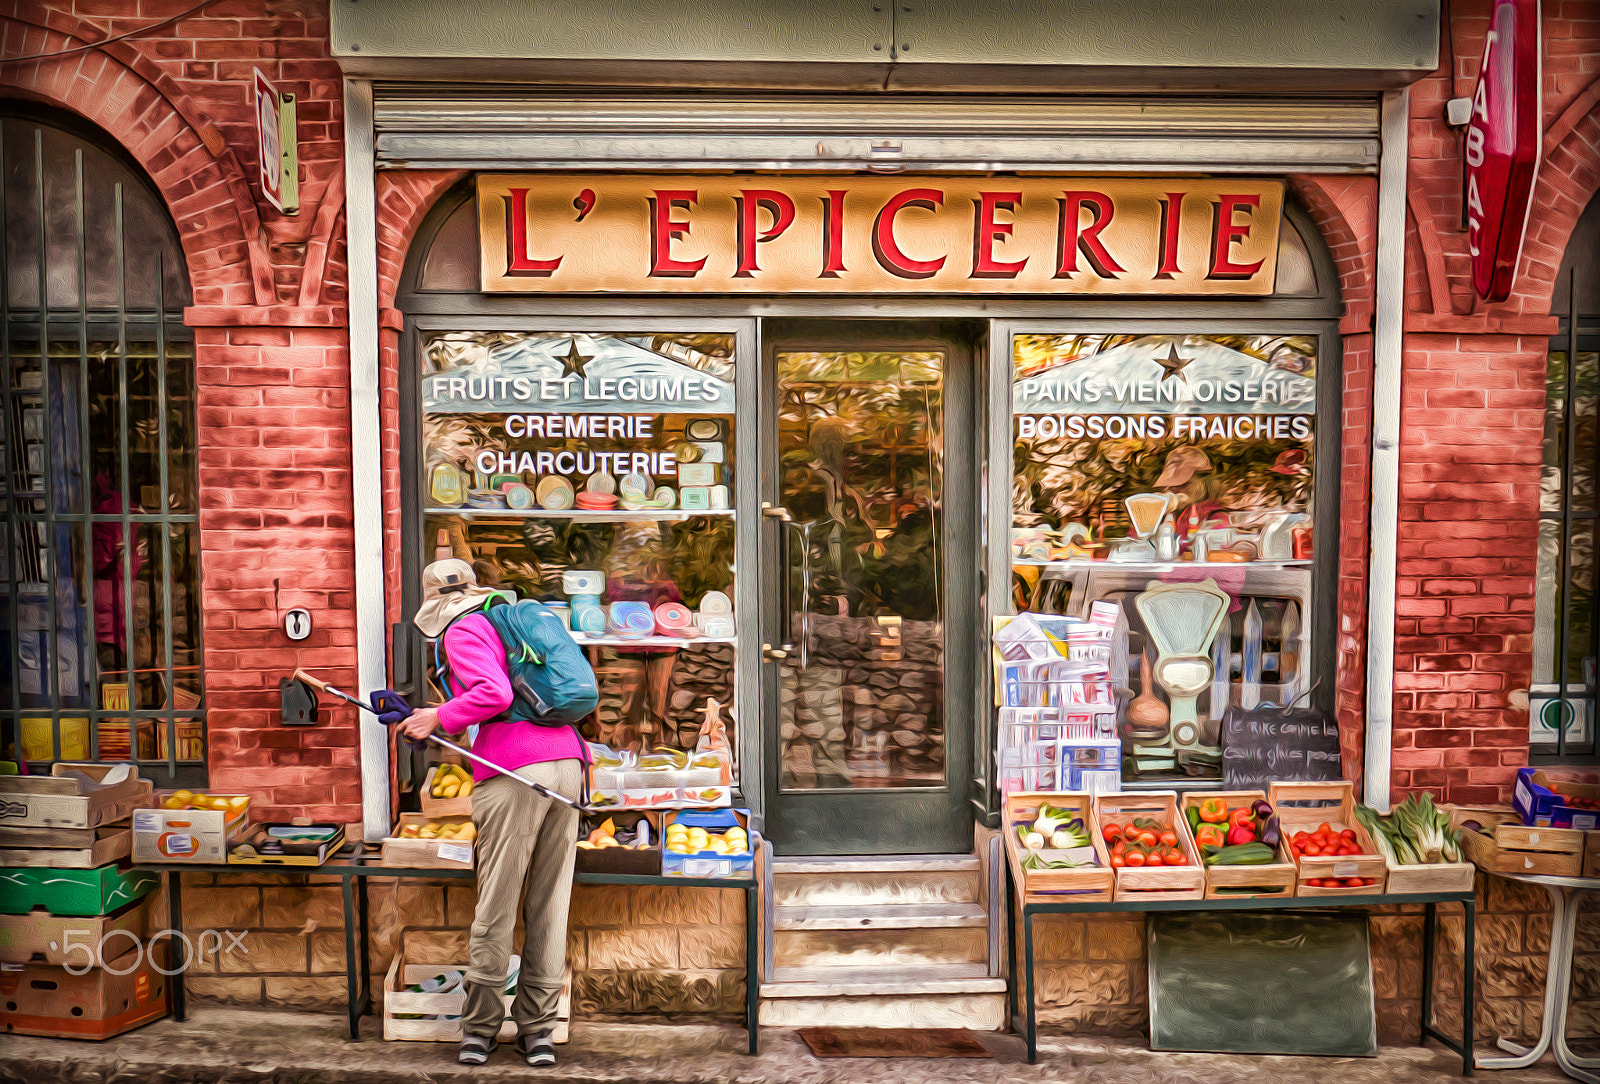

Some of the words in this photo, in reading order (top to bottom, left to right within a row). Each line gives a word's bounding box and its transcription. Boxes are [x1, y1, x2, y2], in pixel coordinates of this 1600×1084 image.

[1466, 29, 1498, 258] TABAC
[432, 377, 532, 400] FRUITS
[540, 378, 573, 400] ET
[583, 377, 721, 401] LEGUMES
[1018, 415, 1166, 439] BOISSONS
[1173, 415, 1310, 440] FRAICHES
[476, 450, 678, 476] CHARCUTERIE
